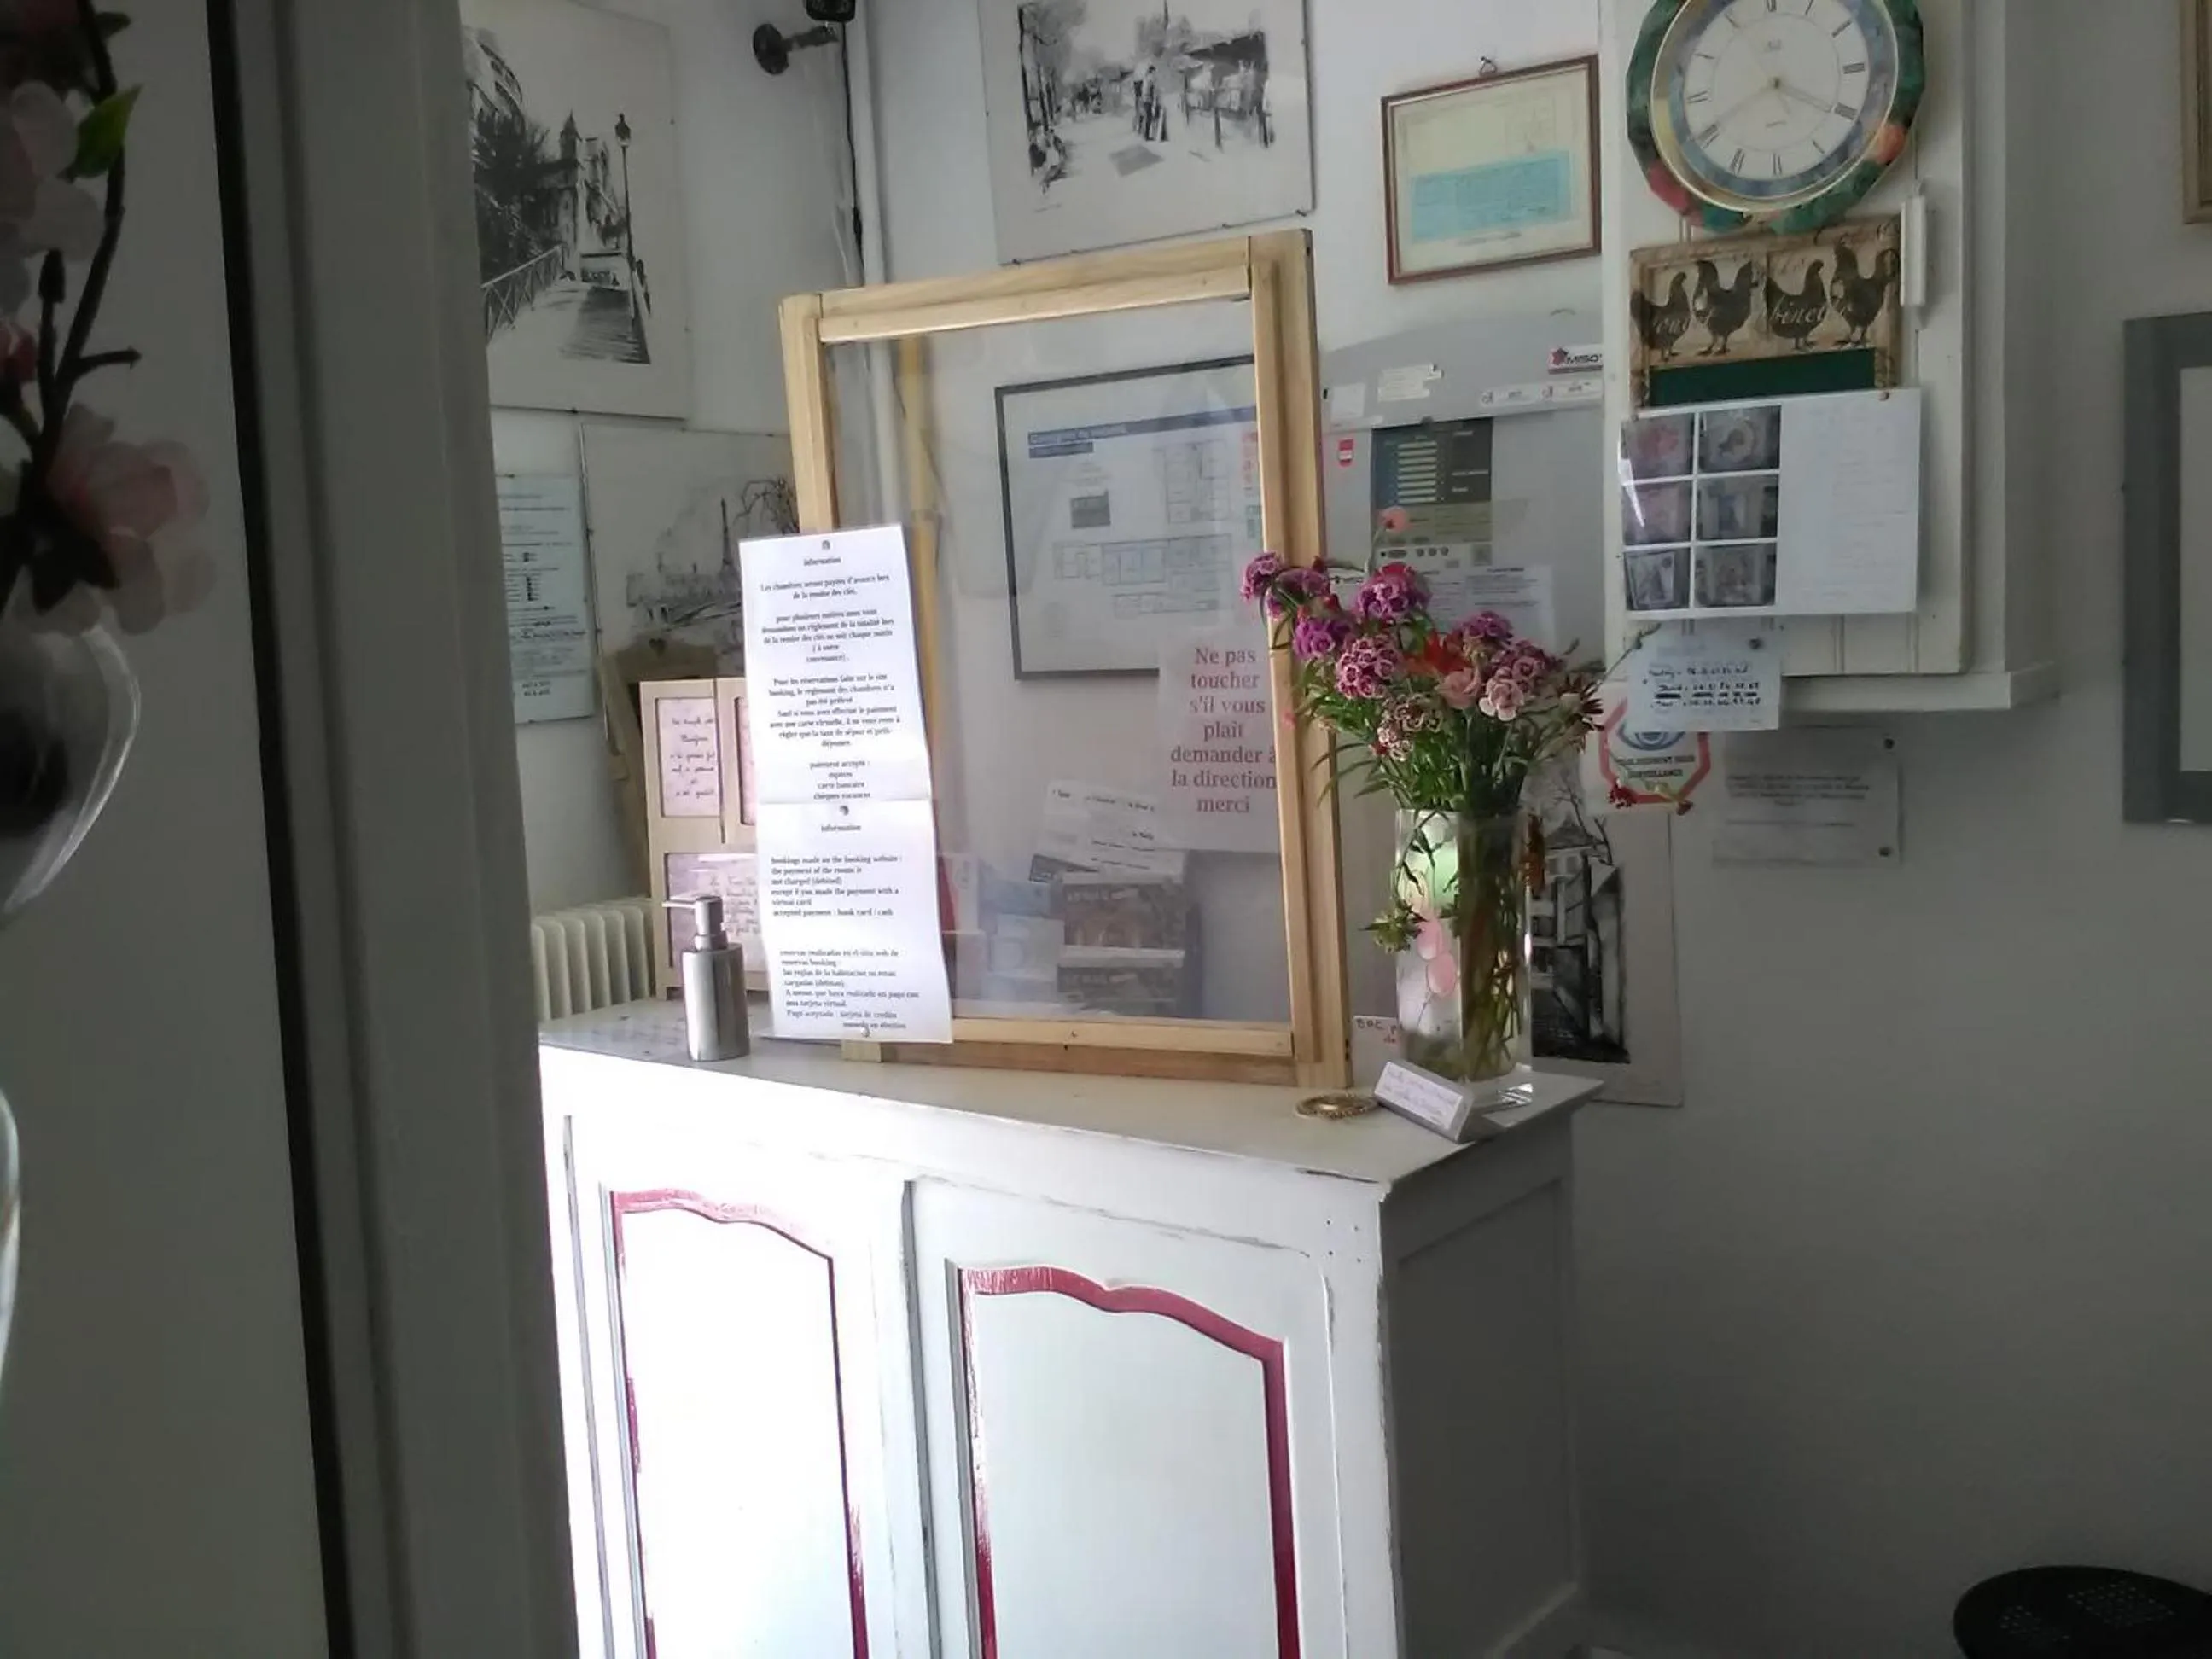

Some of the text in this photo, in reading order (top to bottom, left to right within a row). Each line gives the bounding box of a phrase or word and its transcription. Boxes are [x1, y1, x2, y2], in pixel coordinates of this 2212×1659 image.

[1196, 647, 1256, 667] Ne pas
[1190, 671, 1260, 690] toucher
[1190, 695, 1266, 714] s'il vous
[1170, 745, 1263, 763] demander
[1172, 770, 1278, 789] la direction
[1197, 796, 1250, 813] merci
